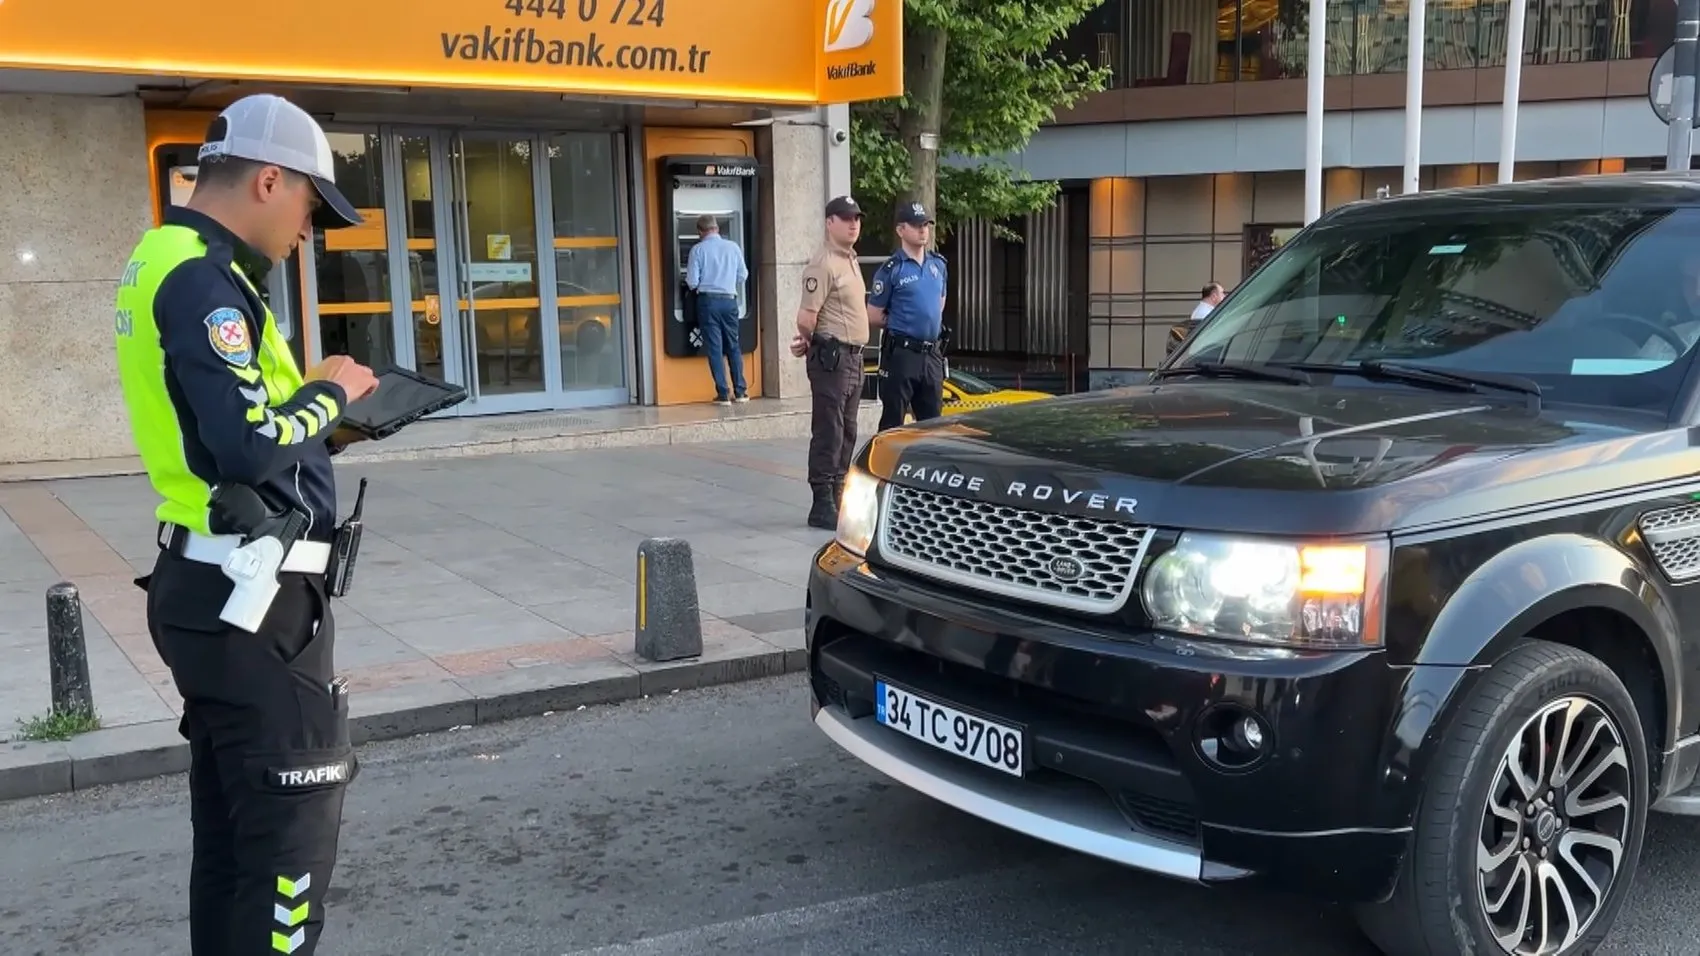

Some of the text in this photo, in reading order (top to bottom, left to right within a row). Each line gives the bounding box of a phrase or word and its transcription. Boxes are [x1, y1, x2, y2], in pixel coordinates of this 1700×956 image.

[505, 0, 665, 27] 444 0 724
[440, 25, 711, 73] vakifbank.com.tr
[896, 463, 1139, 514] RANGE ROVER
[887, 689, 1019, 770] 34 TC 9708
